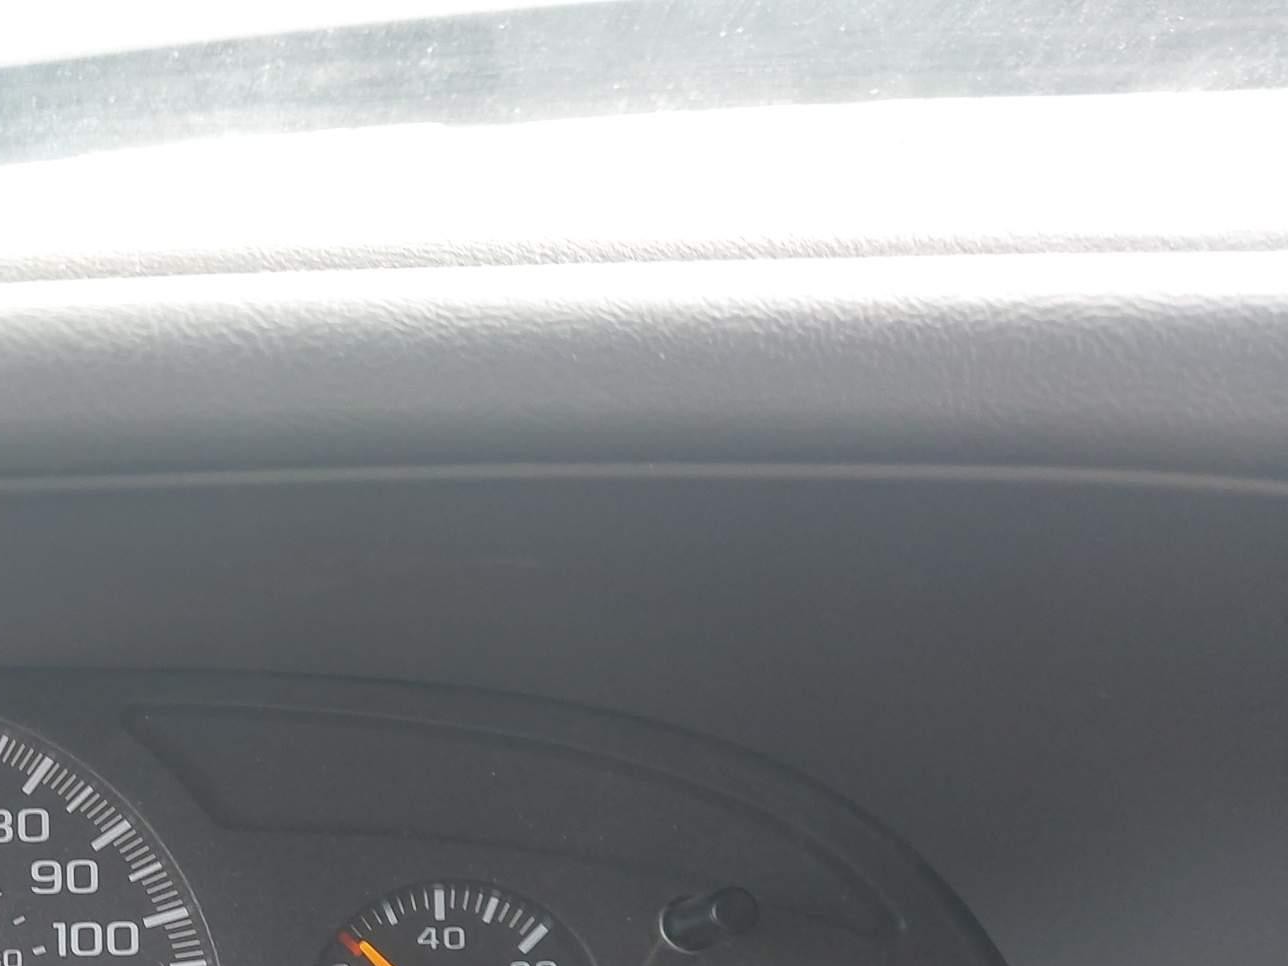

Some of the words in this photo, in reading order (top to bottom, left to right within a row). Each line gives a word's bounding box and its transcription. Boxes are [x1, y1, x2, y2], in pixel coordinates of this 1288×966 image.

[31, 859, 99, 894] 90
[52, 921, 138, 957] 100
[417, 927, 465, 950] 40
